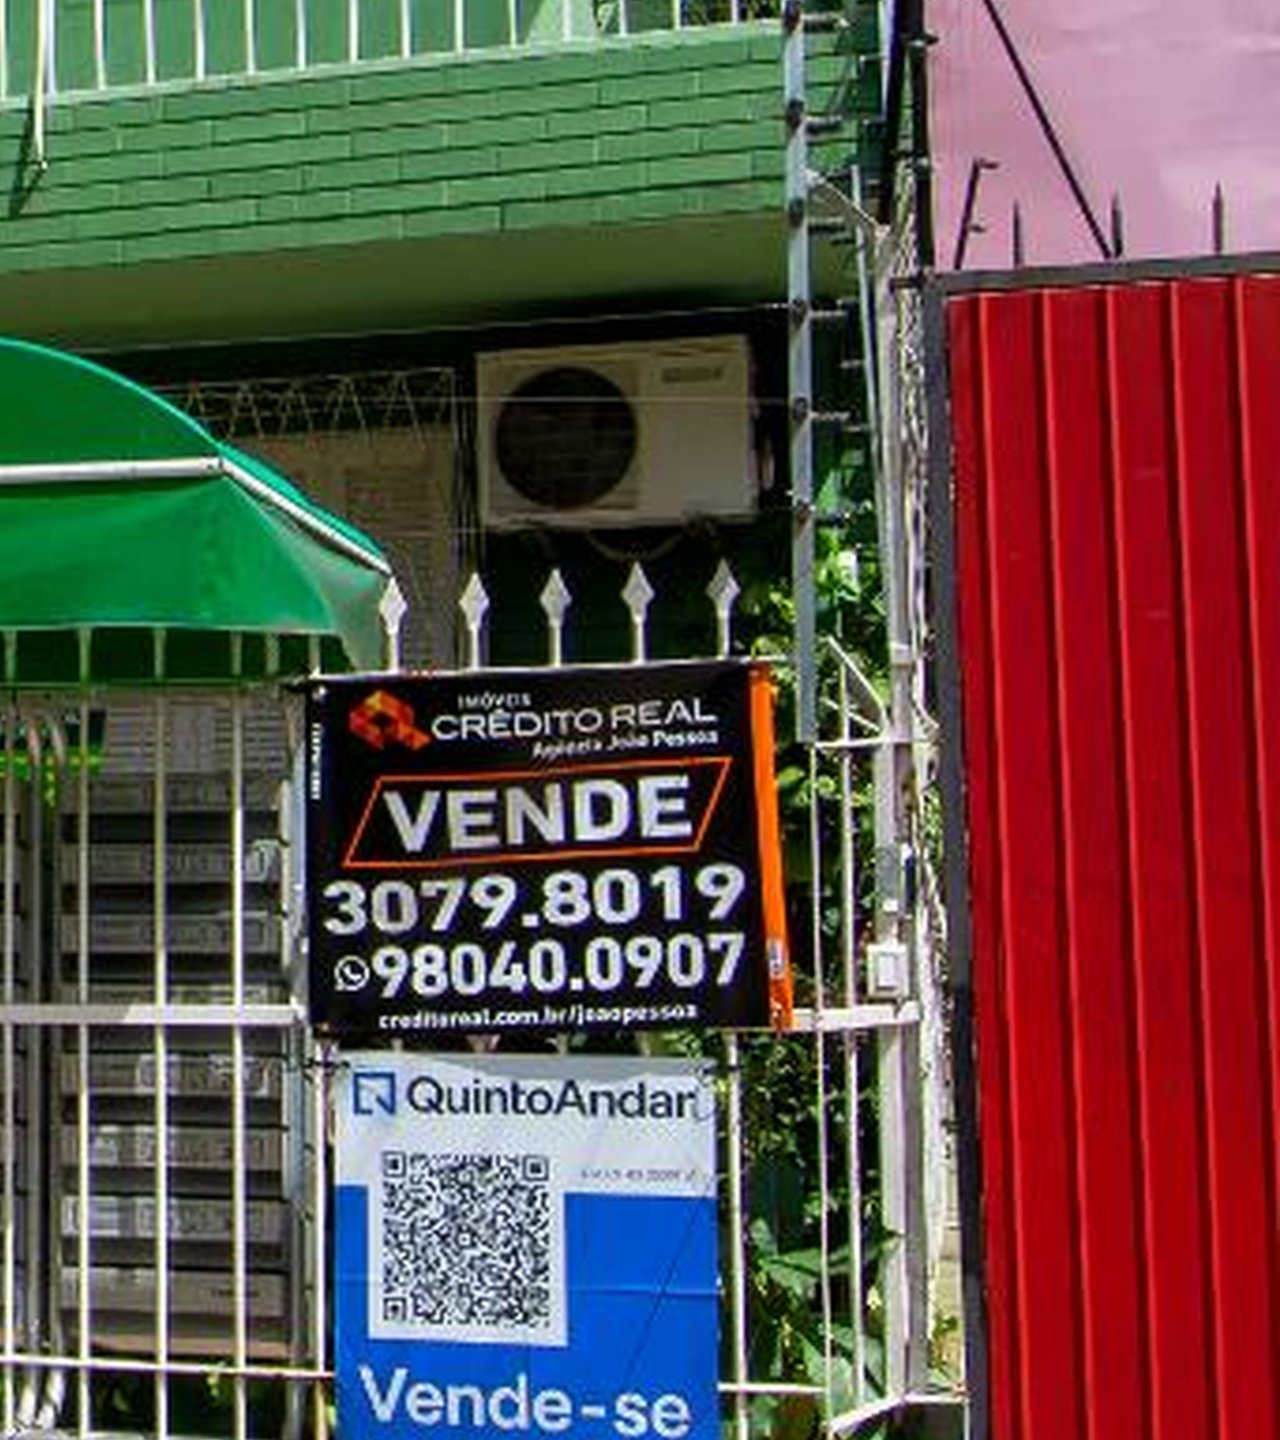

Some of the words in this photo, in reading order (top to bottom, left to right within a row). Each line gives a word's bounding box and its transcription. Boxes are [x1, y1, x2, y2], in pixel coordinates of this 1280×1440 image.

[611, 697, 718, 730] REAL
[652, 729, 719, 748] Pessoa
[383, 774, 694, 853] VENDE
[322, 863, 746, 936] 3079.8019
[371, 932, 746, 999] 98040.0907
[406, 1076, 698, 1120] QuintoAndar
[359, 1365, 691, 1438] Vende-se
